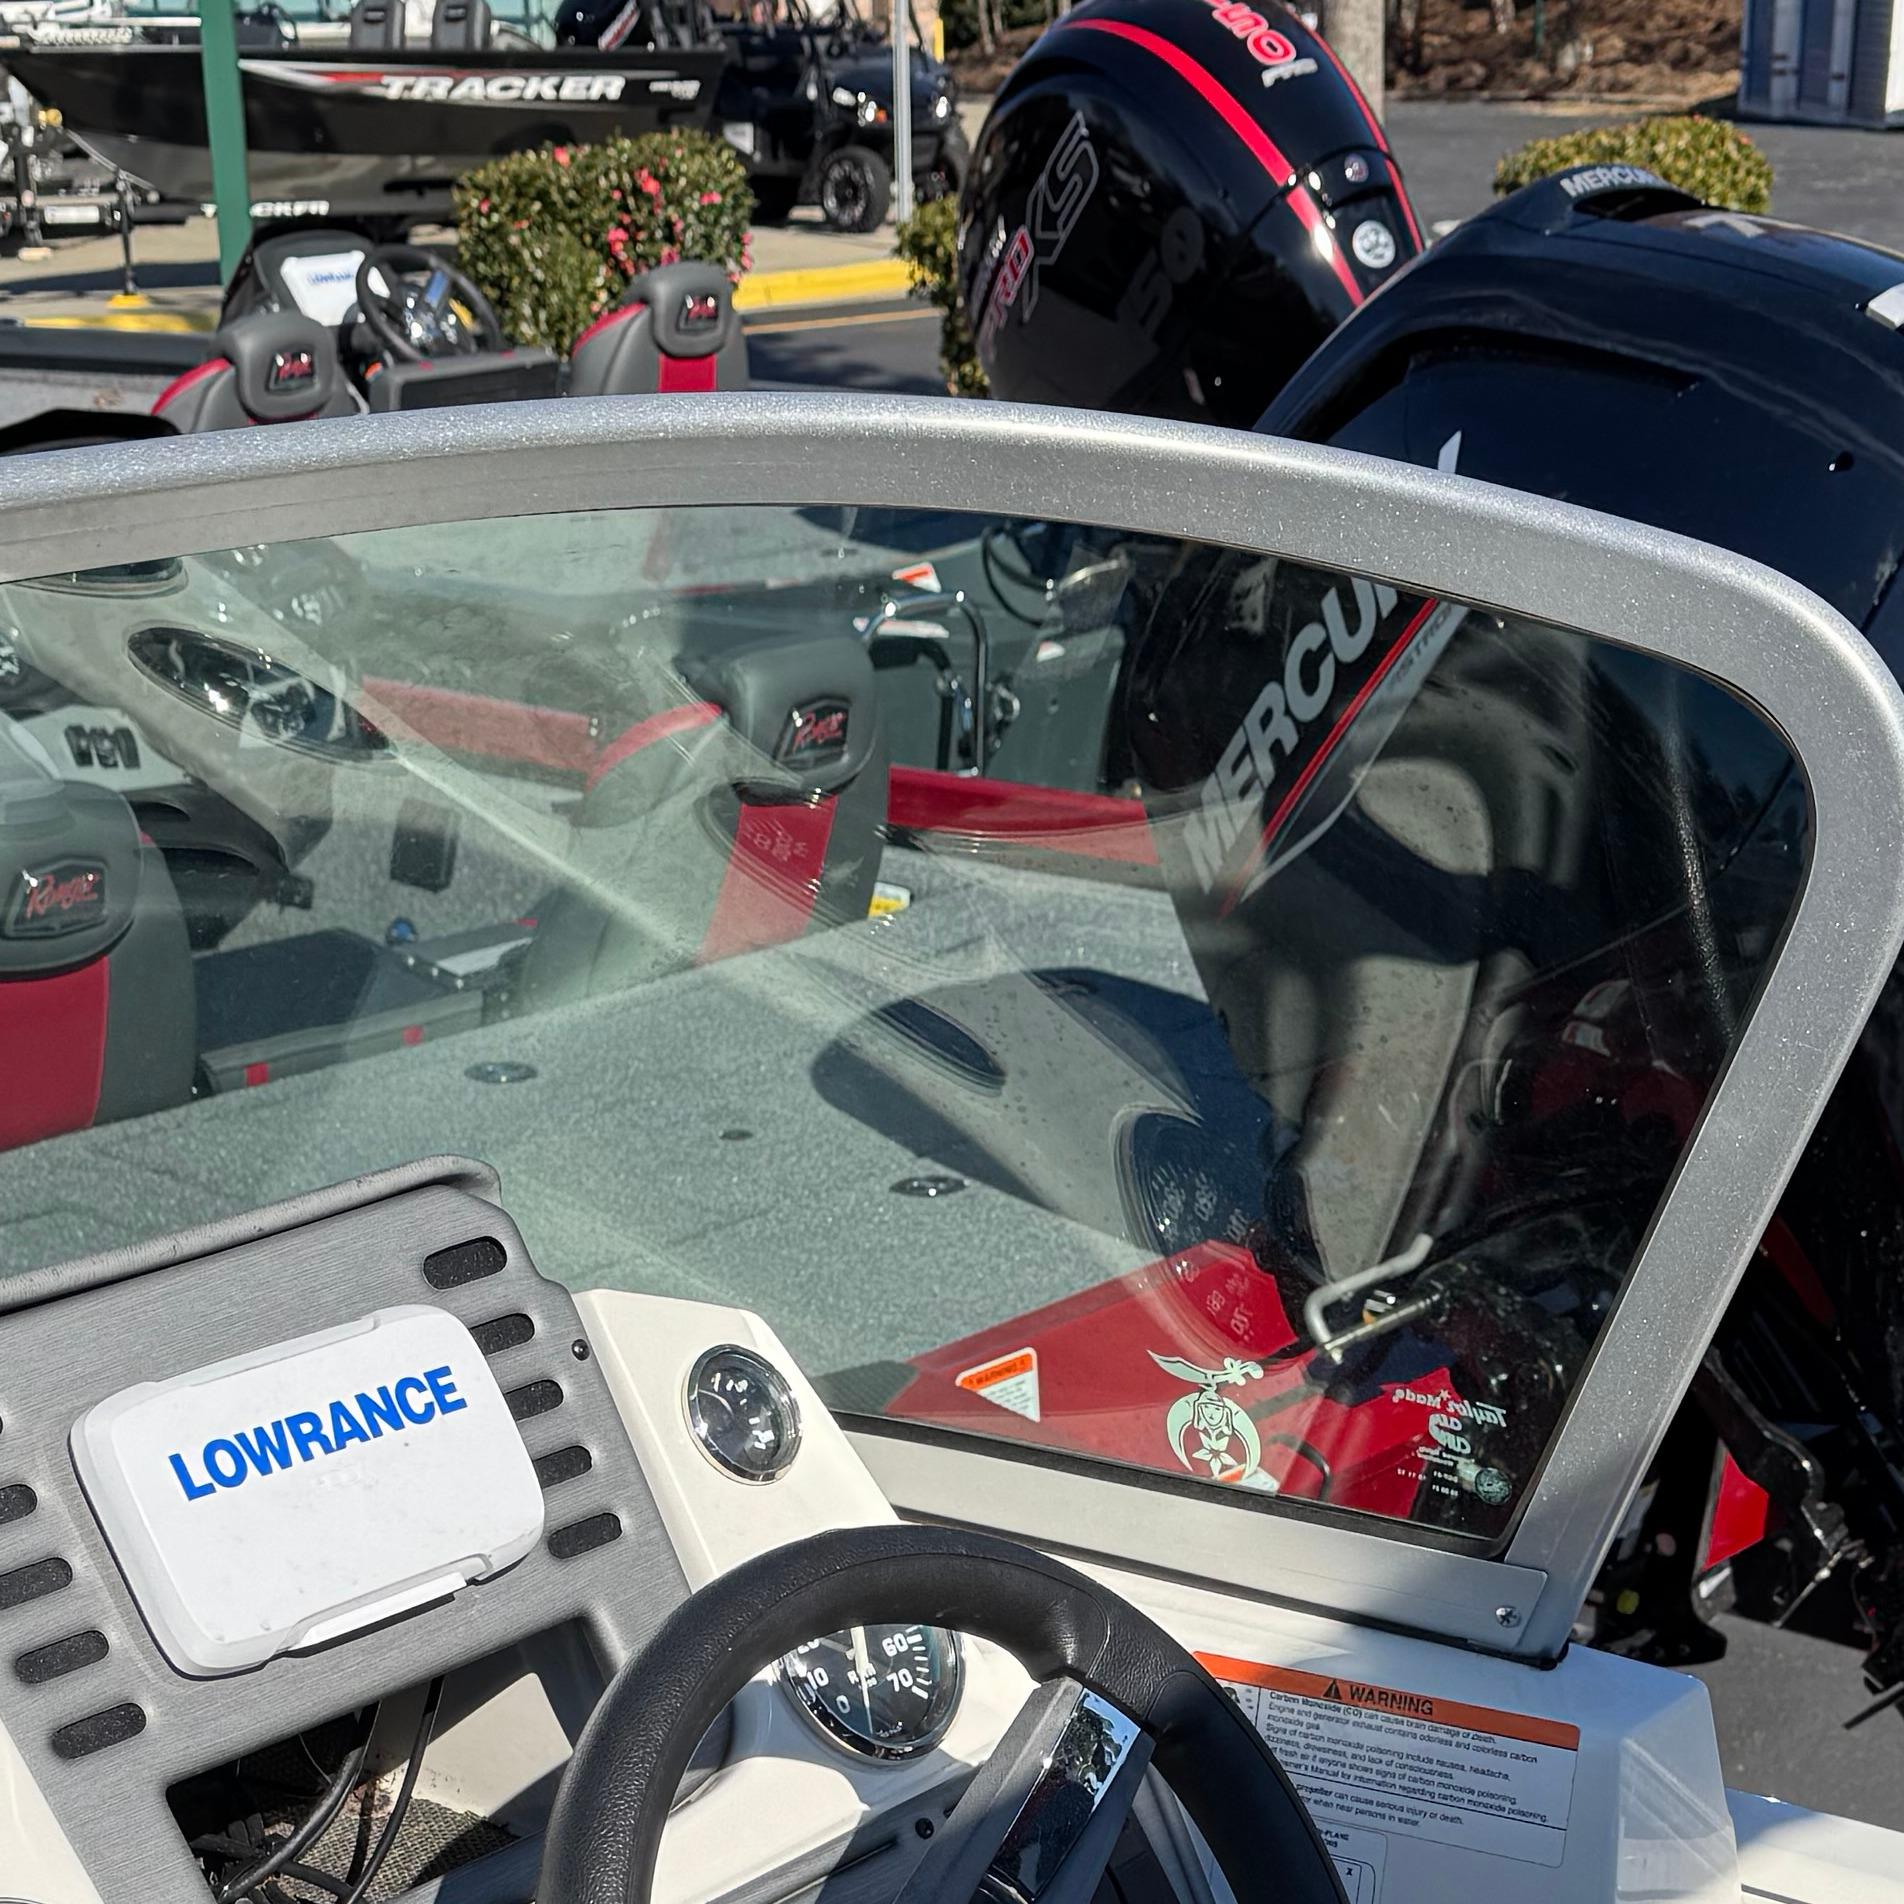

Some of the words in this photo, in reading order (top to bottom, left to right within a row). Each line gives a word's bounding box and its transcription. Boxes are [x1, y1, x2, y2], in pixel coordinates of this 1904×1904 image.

[382, 75, 625, 100] TRACKER
[1022, 110, 1099, 322] XS
[1183, 577, 1398, 894] MERCU
[168, 1366, 468, 1501] LOWRANCE
[881, 1632, 909, 1657] 60
[806, 1667, 830, 1690] 10
[886, 1668, 914, 1692] 70
[835, 1695, 851, 1714] 0
[1269, 1691, 1299, 1704] Carbon
[1343, 1706, 1362, 1718] (CO)
[1350, 1685, 1433, 1716] WARNING
[1265, 1723, 1287, 1735] Signs
[1298, 1730, 1325, 1742] carbon
[1405, 1752, 1433, 1764] include
[1268, 1702, 1294, 1715] Engine
[1296, 1708, 1311, 1718] and
[1313, 1711, 1349, 1726] generator
[1454, 1740, 1470, 1750] and
[1509, 1751, 1537, 1764] carbon
[1350, 1751, 1365, 1761] and
[1367, 1754, 1382, 1764] lack
[1407, 1774, 1435, 1786] carbon
[1436, 1780, 1475, 1795] monoxide
[1437, 1791, 1465, 1804] carbon
[1467, 1797, 1505, 1812] monoxide
